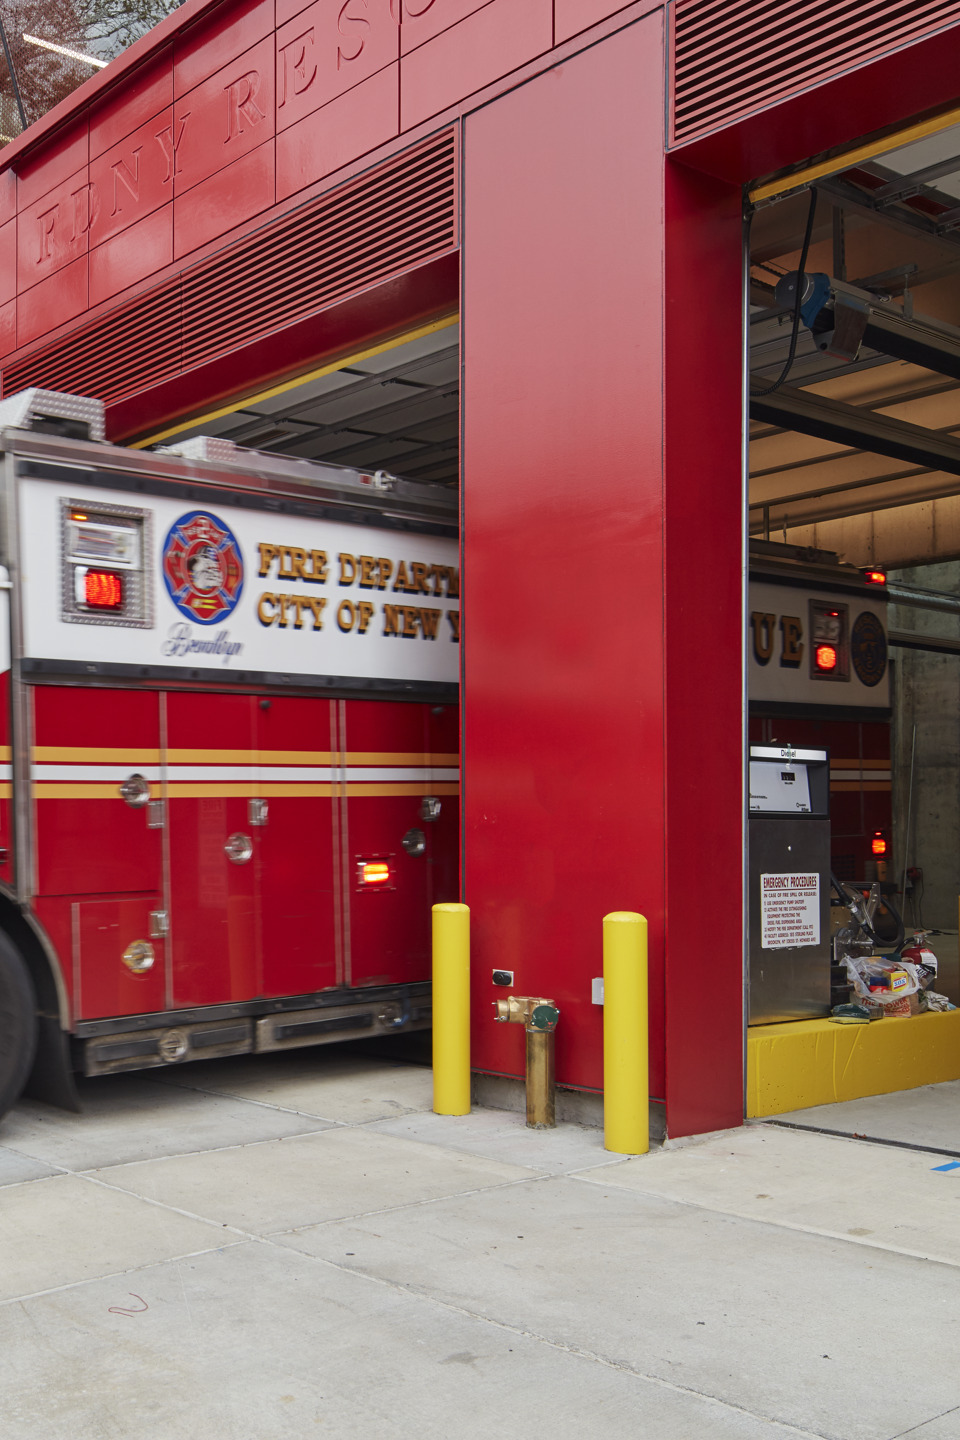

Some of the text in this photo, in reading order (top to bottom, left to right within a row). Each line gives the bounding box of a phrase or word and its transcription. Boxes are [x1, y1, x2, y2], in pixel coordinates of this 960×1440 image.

[36, 111, 192, 265] FDNY
[256, 541, 330, 584] FIRE
[256, 591, 327, 632] CITY
[336, 599, 375, 635] OF
[382, 605, 443, 642] NEW
[764, 876, 816, 888] EMERGENCY PROCEDURES
